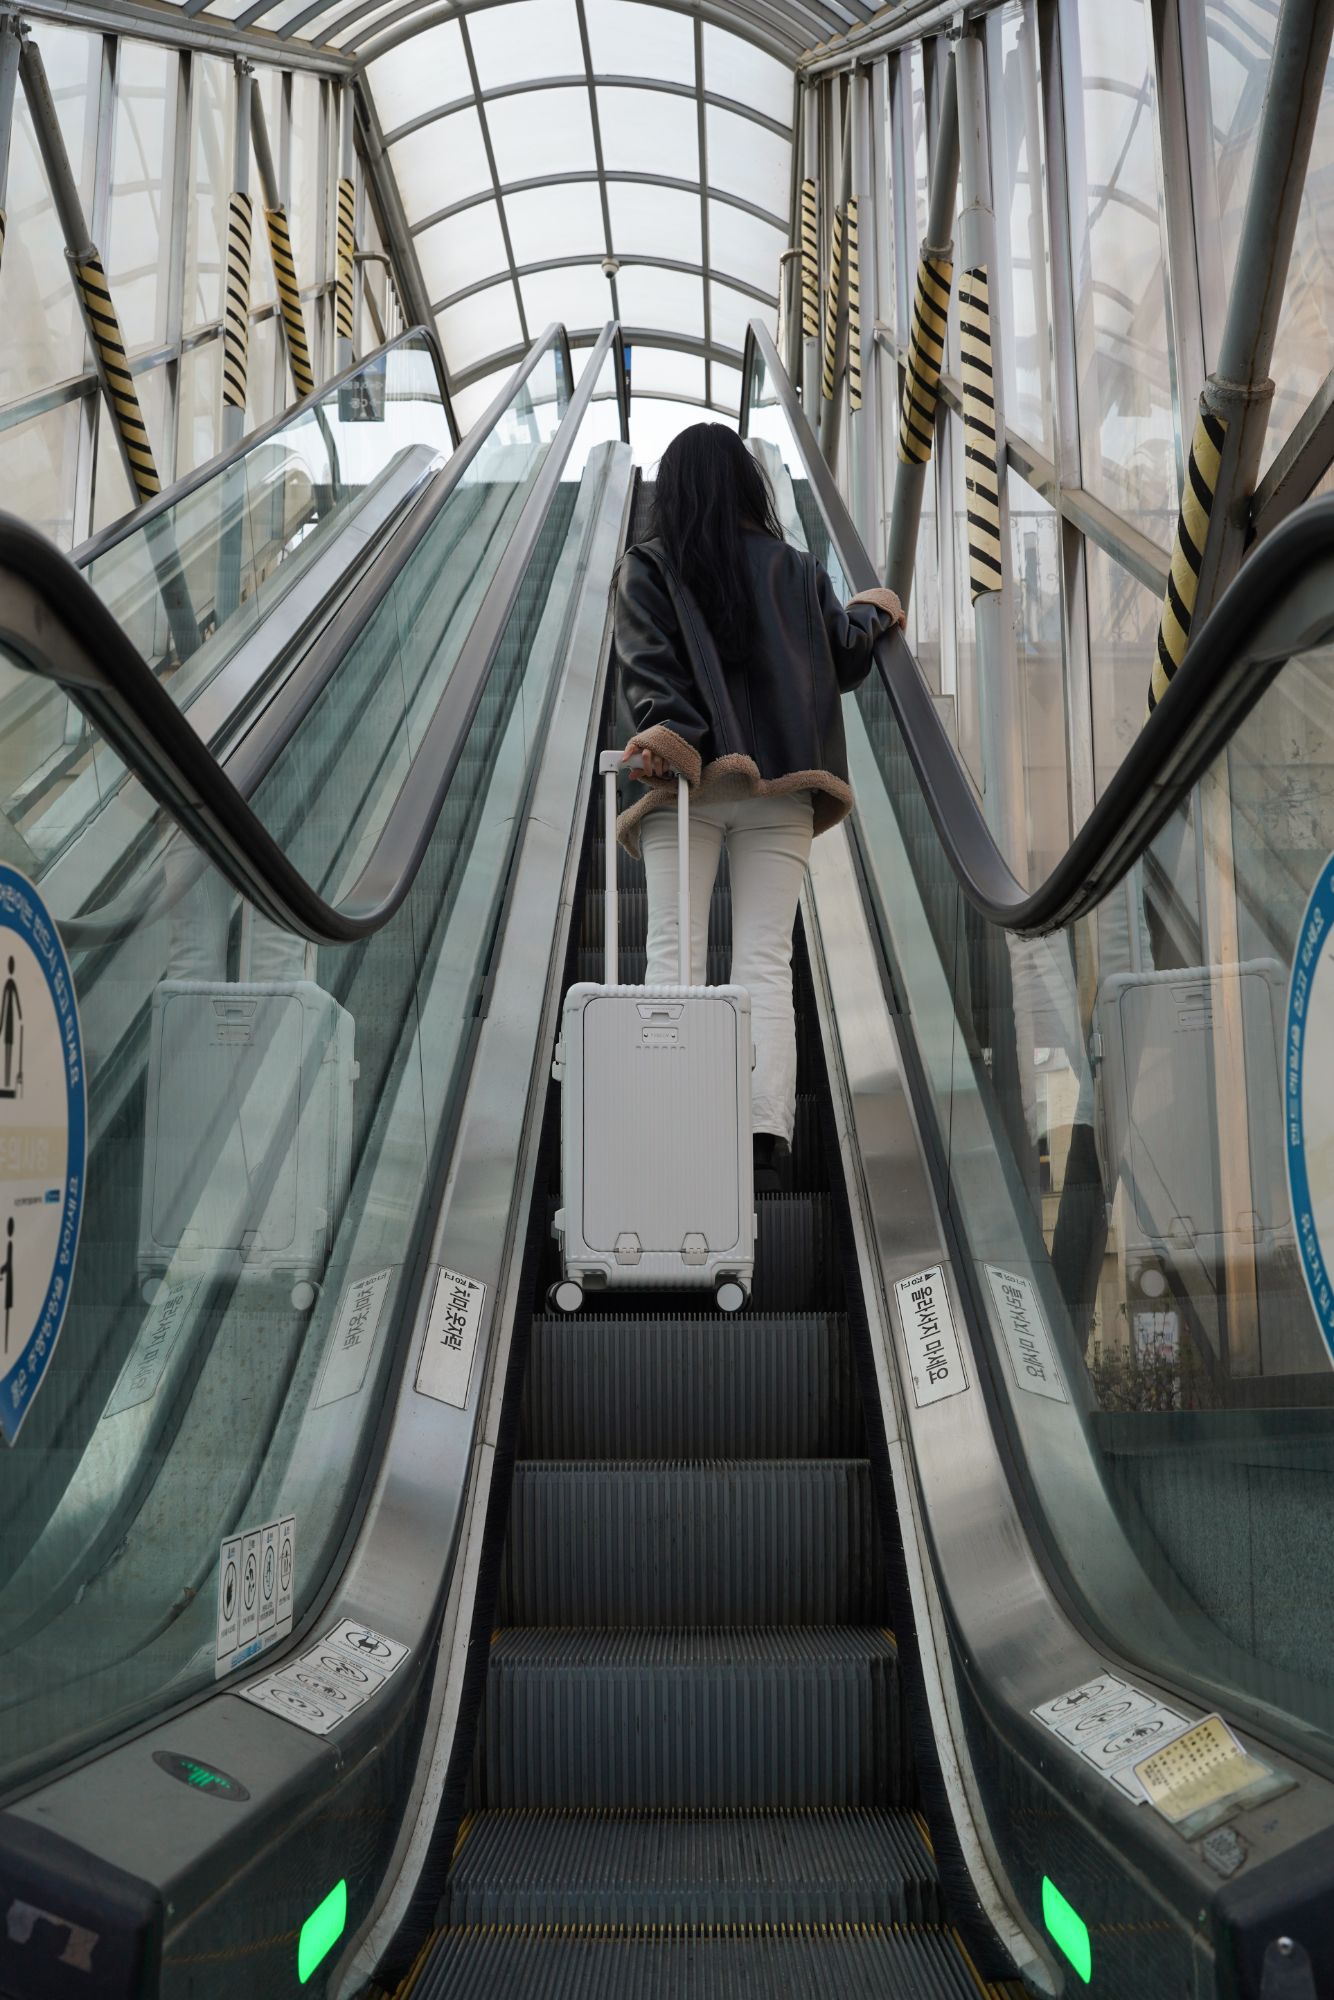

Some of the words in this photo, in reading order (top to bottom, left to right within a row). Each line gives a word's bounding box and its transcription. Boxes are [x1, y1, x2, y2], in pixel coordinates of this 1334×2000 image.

[444, 1271, 467, 1287] 경고
[901, 1275, 923, 1290] 경고
[911, 1286, 941, 1340] 올라서지
[923, 1339, 949, 1385] 마세요
